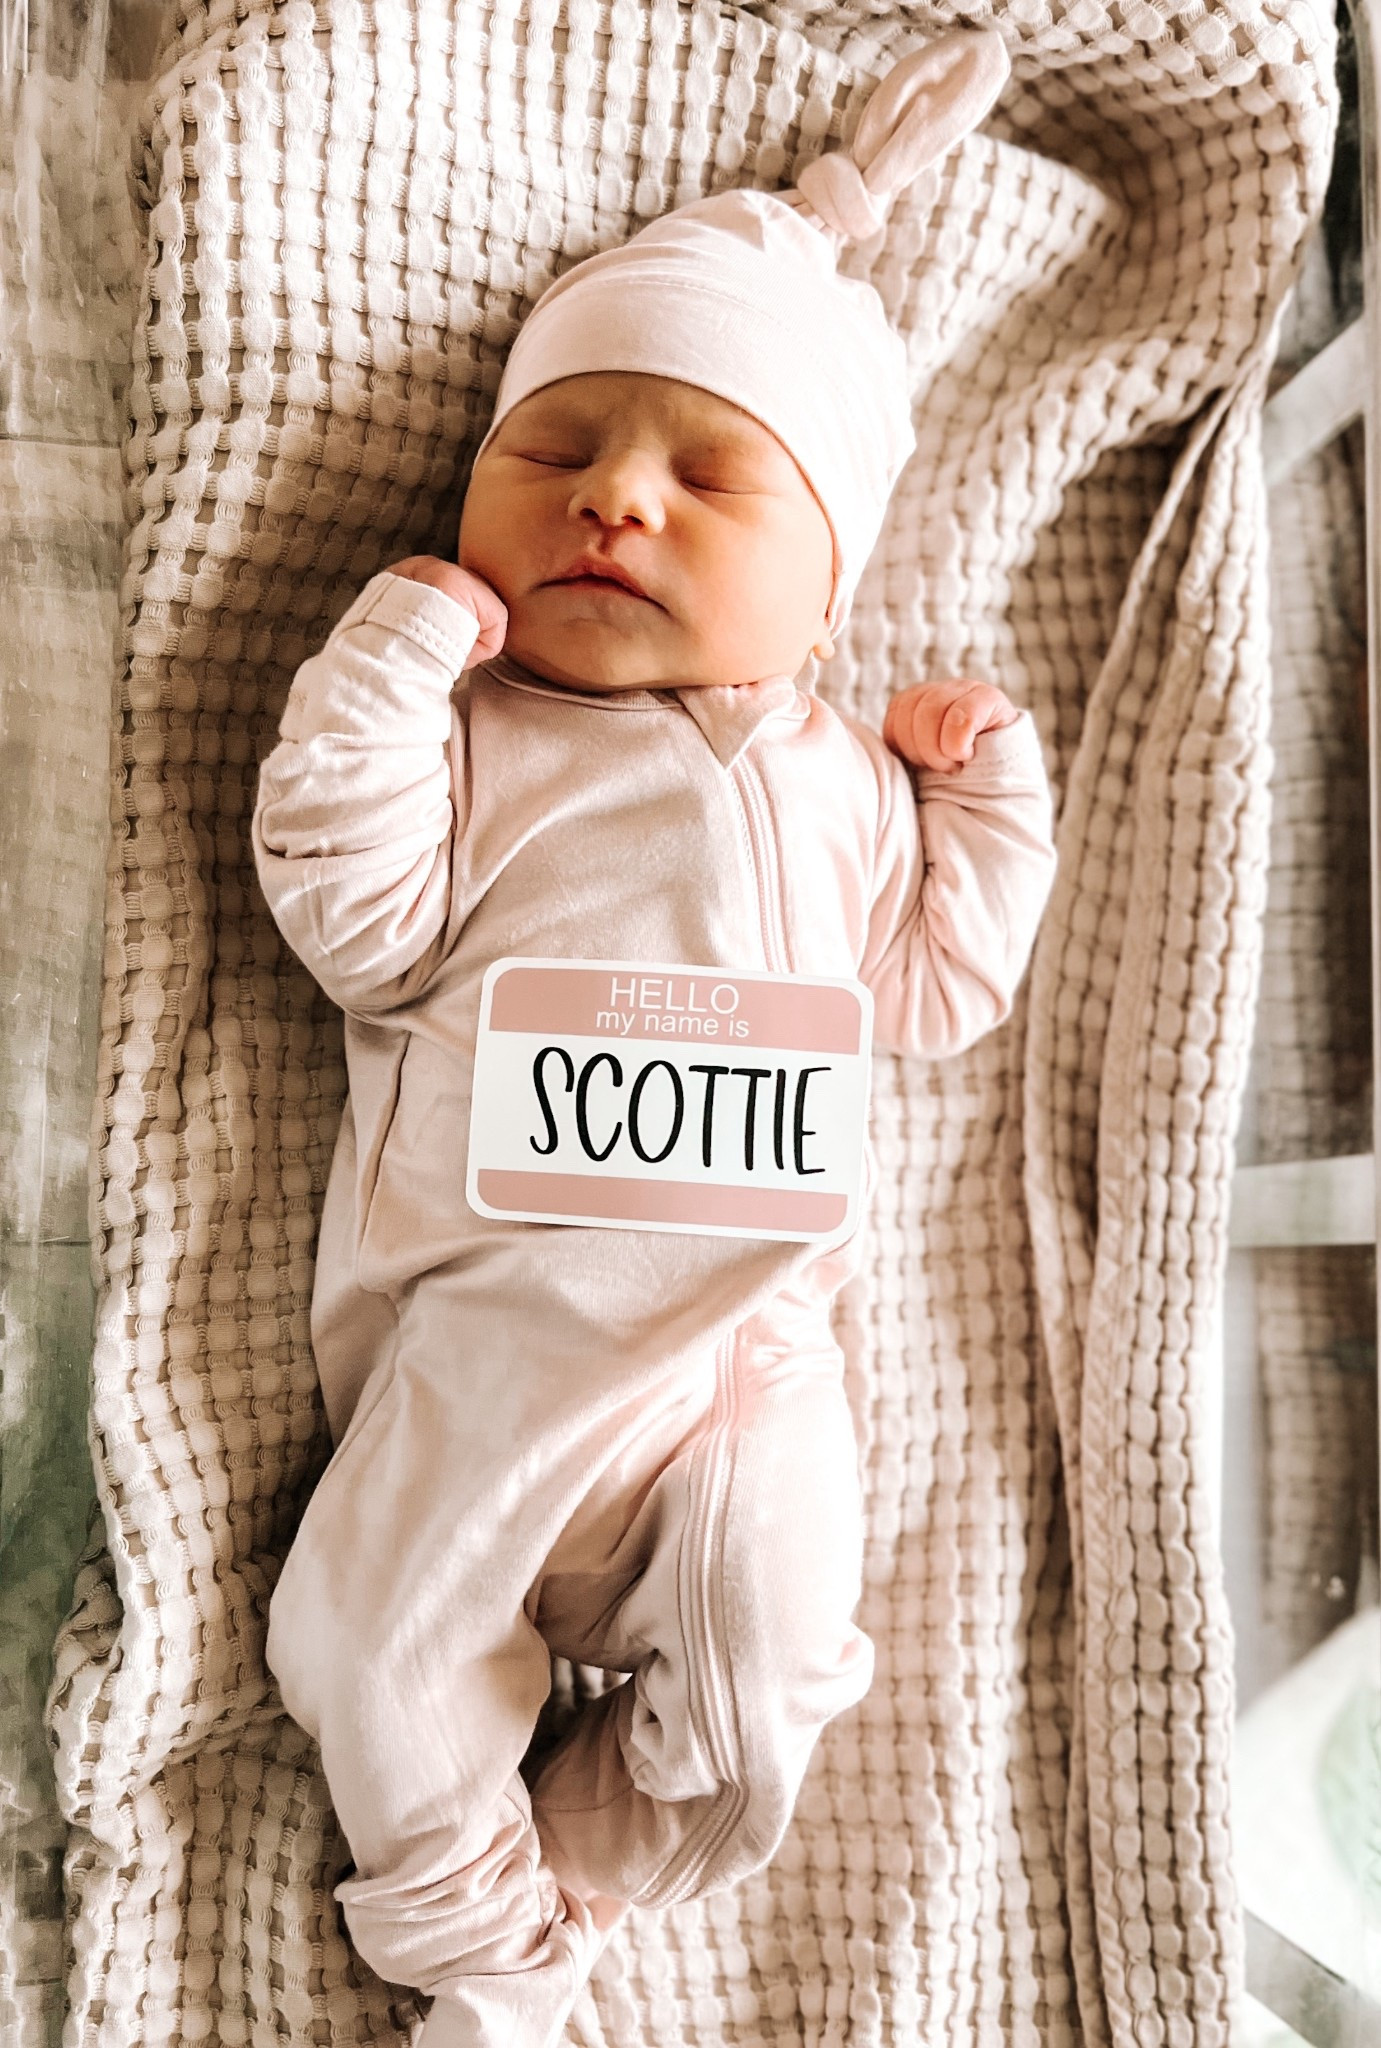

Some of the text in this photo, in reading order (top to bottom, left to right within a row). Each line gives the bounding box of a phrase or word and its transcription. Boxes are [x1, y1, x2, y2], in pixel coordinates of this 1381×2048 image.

[610, 977, 740, 1014] HELLO
[596, 1012, 750, 1038] my name is
[529, 1046, 832, 1175] SCOTTIE
